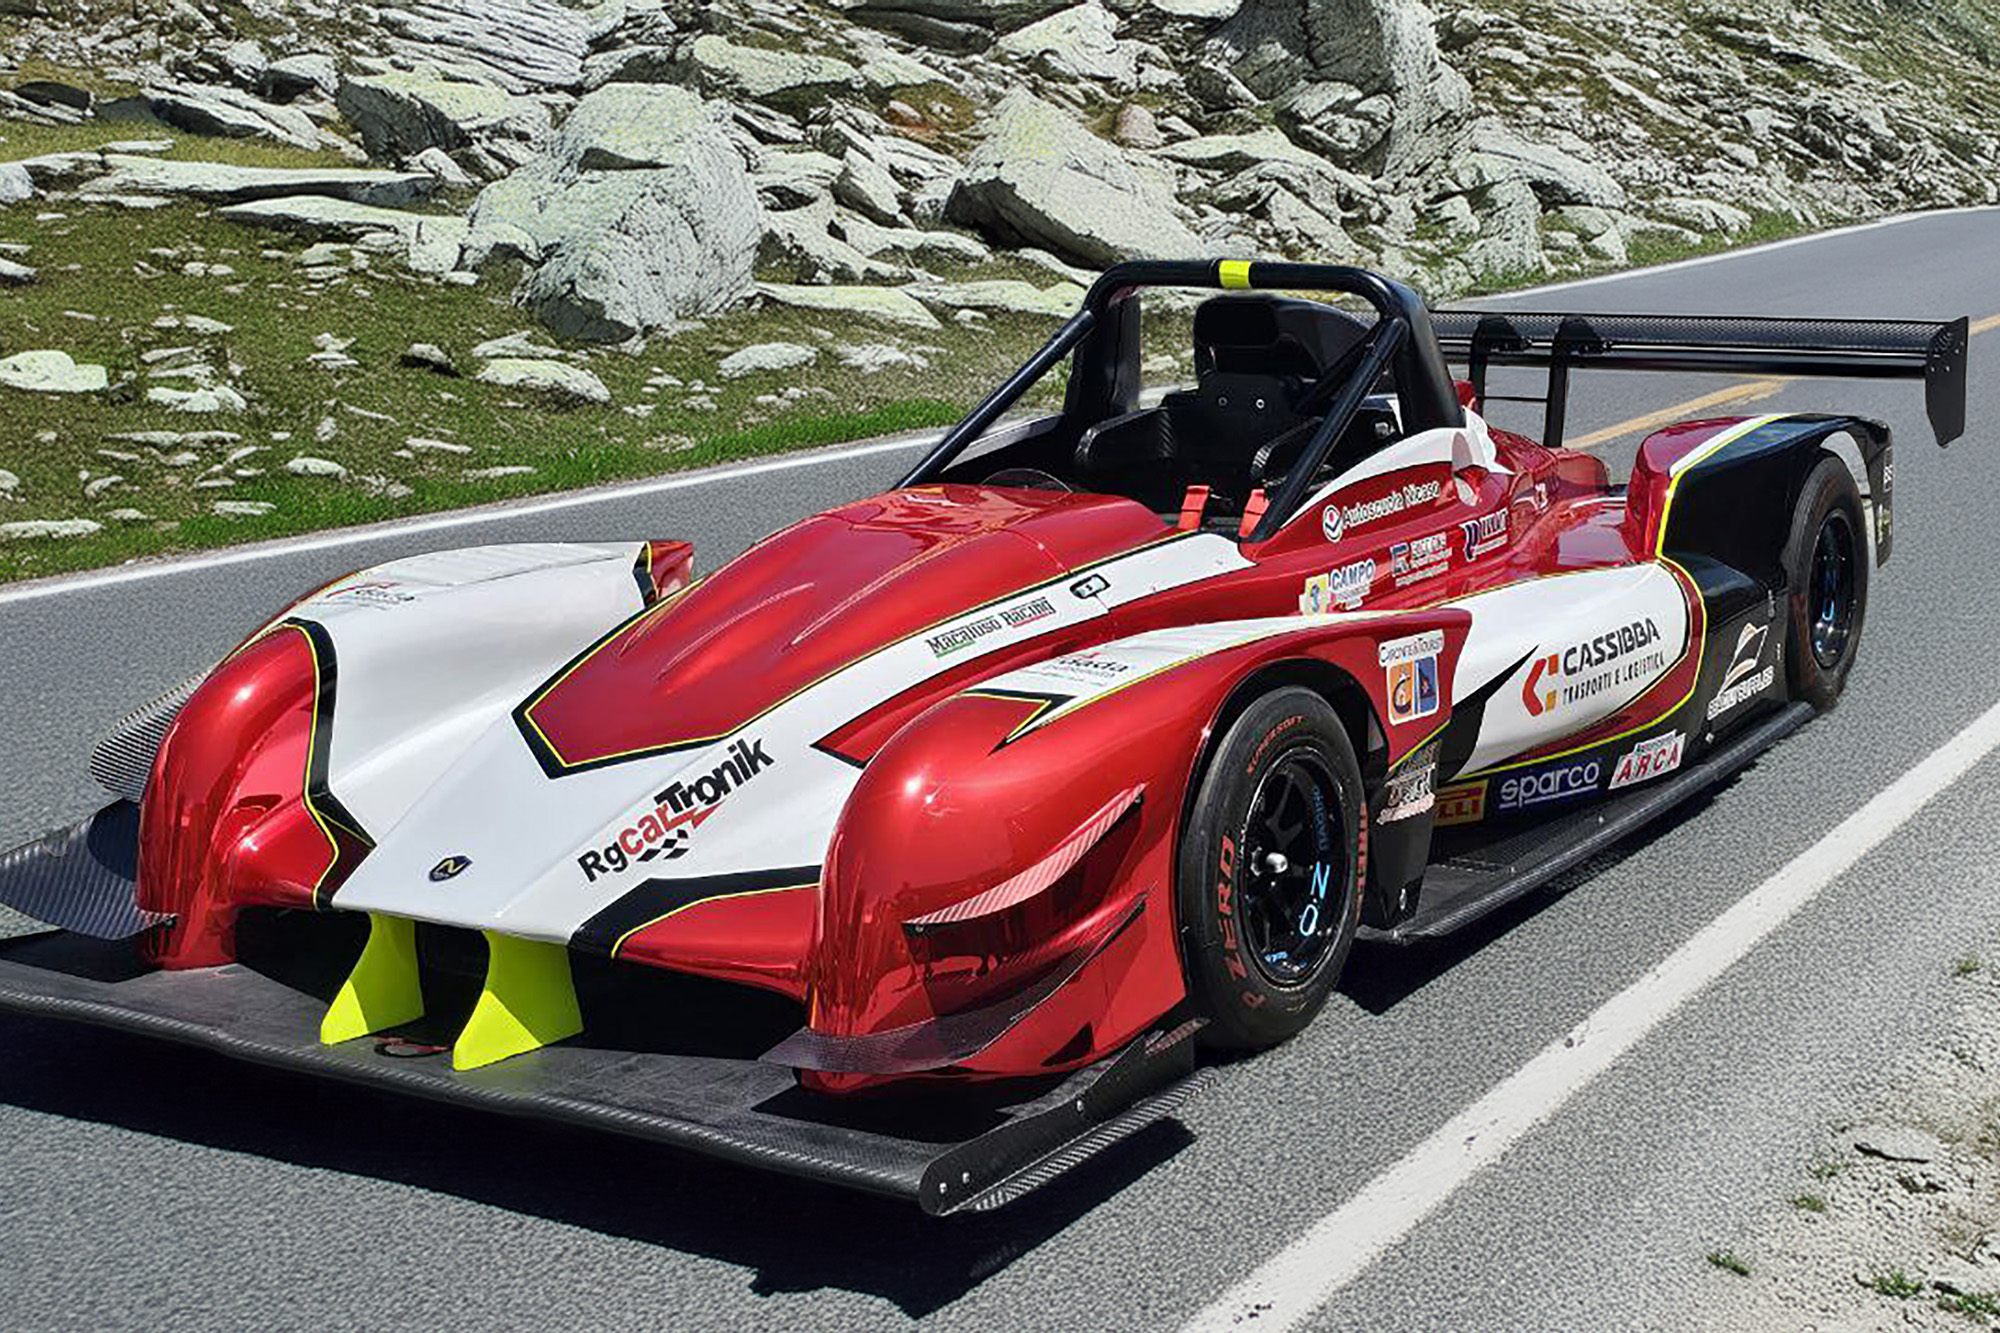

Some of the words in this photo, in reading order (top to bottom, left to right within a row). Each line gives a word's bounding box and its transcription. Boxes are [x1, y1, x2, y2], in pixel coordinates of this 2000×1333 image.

[1331, 559, 1374, 591] CAMPO
[926, 615, 1002, 654] Macaluso
[1001, 597, 1057, 625] Racing
[1563, 618, 1661, 676] CASSIBBA
[1563, 673, 1612, 705] TRASPORTI
[1614, 669, 1621, 686] E
[1501, 762, 1600, 806] sparco
[1617, 742, 1680, 783] ARCA
[1217, 833, 1248, 982] ZERO
